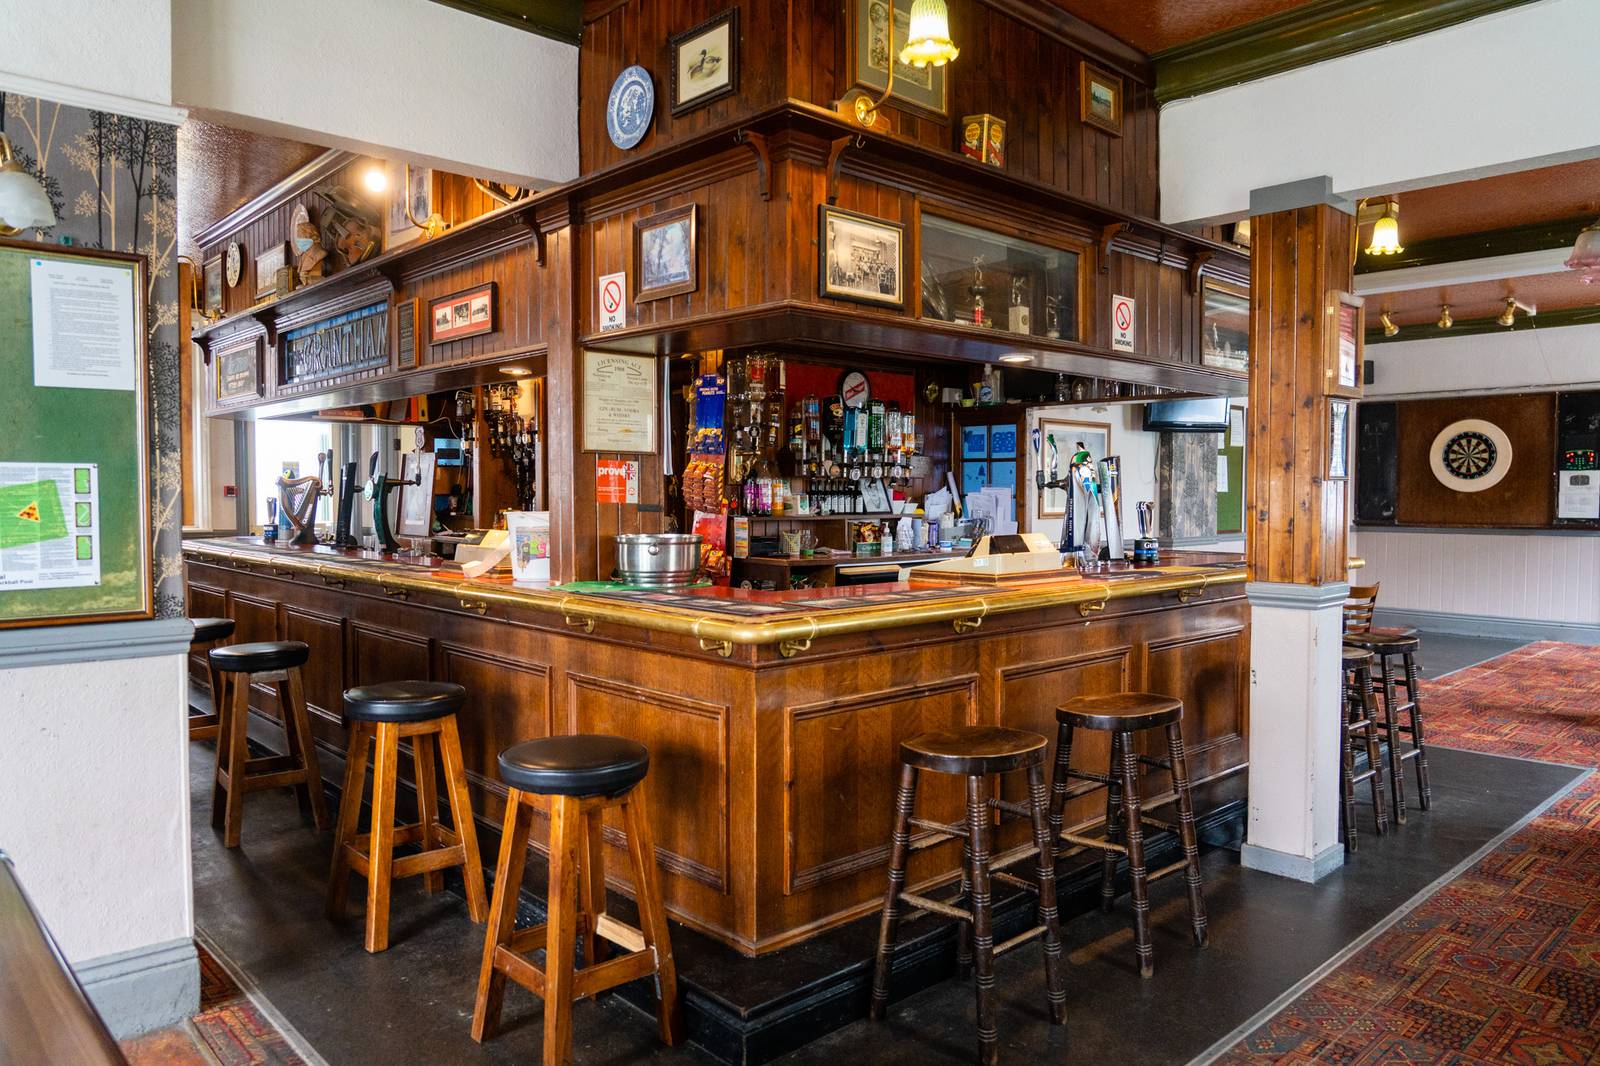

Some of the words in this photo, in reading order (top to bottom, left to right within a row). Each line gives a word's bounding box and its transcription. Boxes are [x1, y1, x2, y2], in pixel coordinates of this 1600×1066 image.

[602, 323, 623, 332] SMOKING
[1114, 339, 1132, 347] SMOKING
[597, 358, 629, 367] LICENSING
